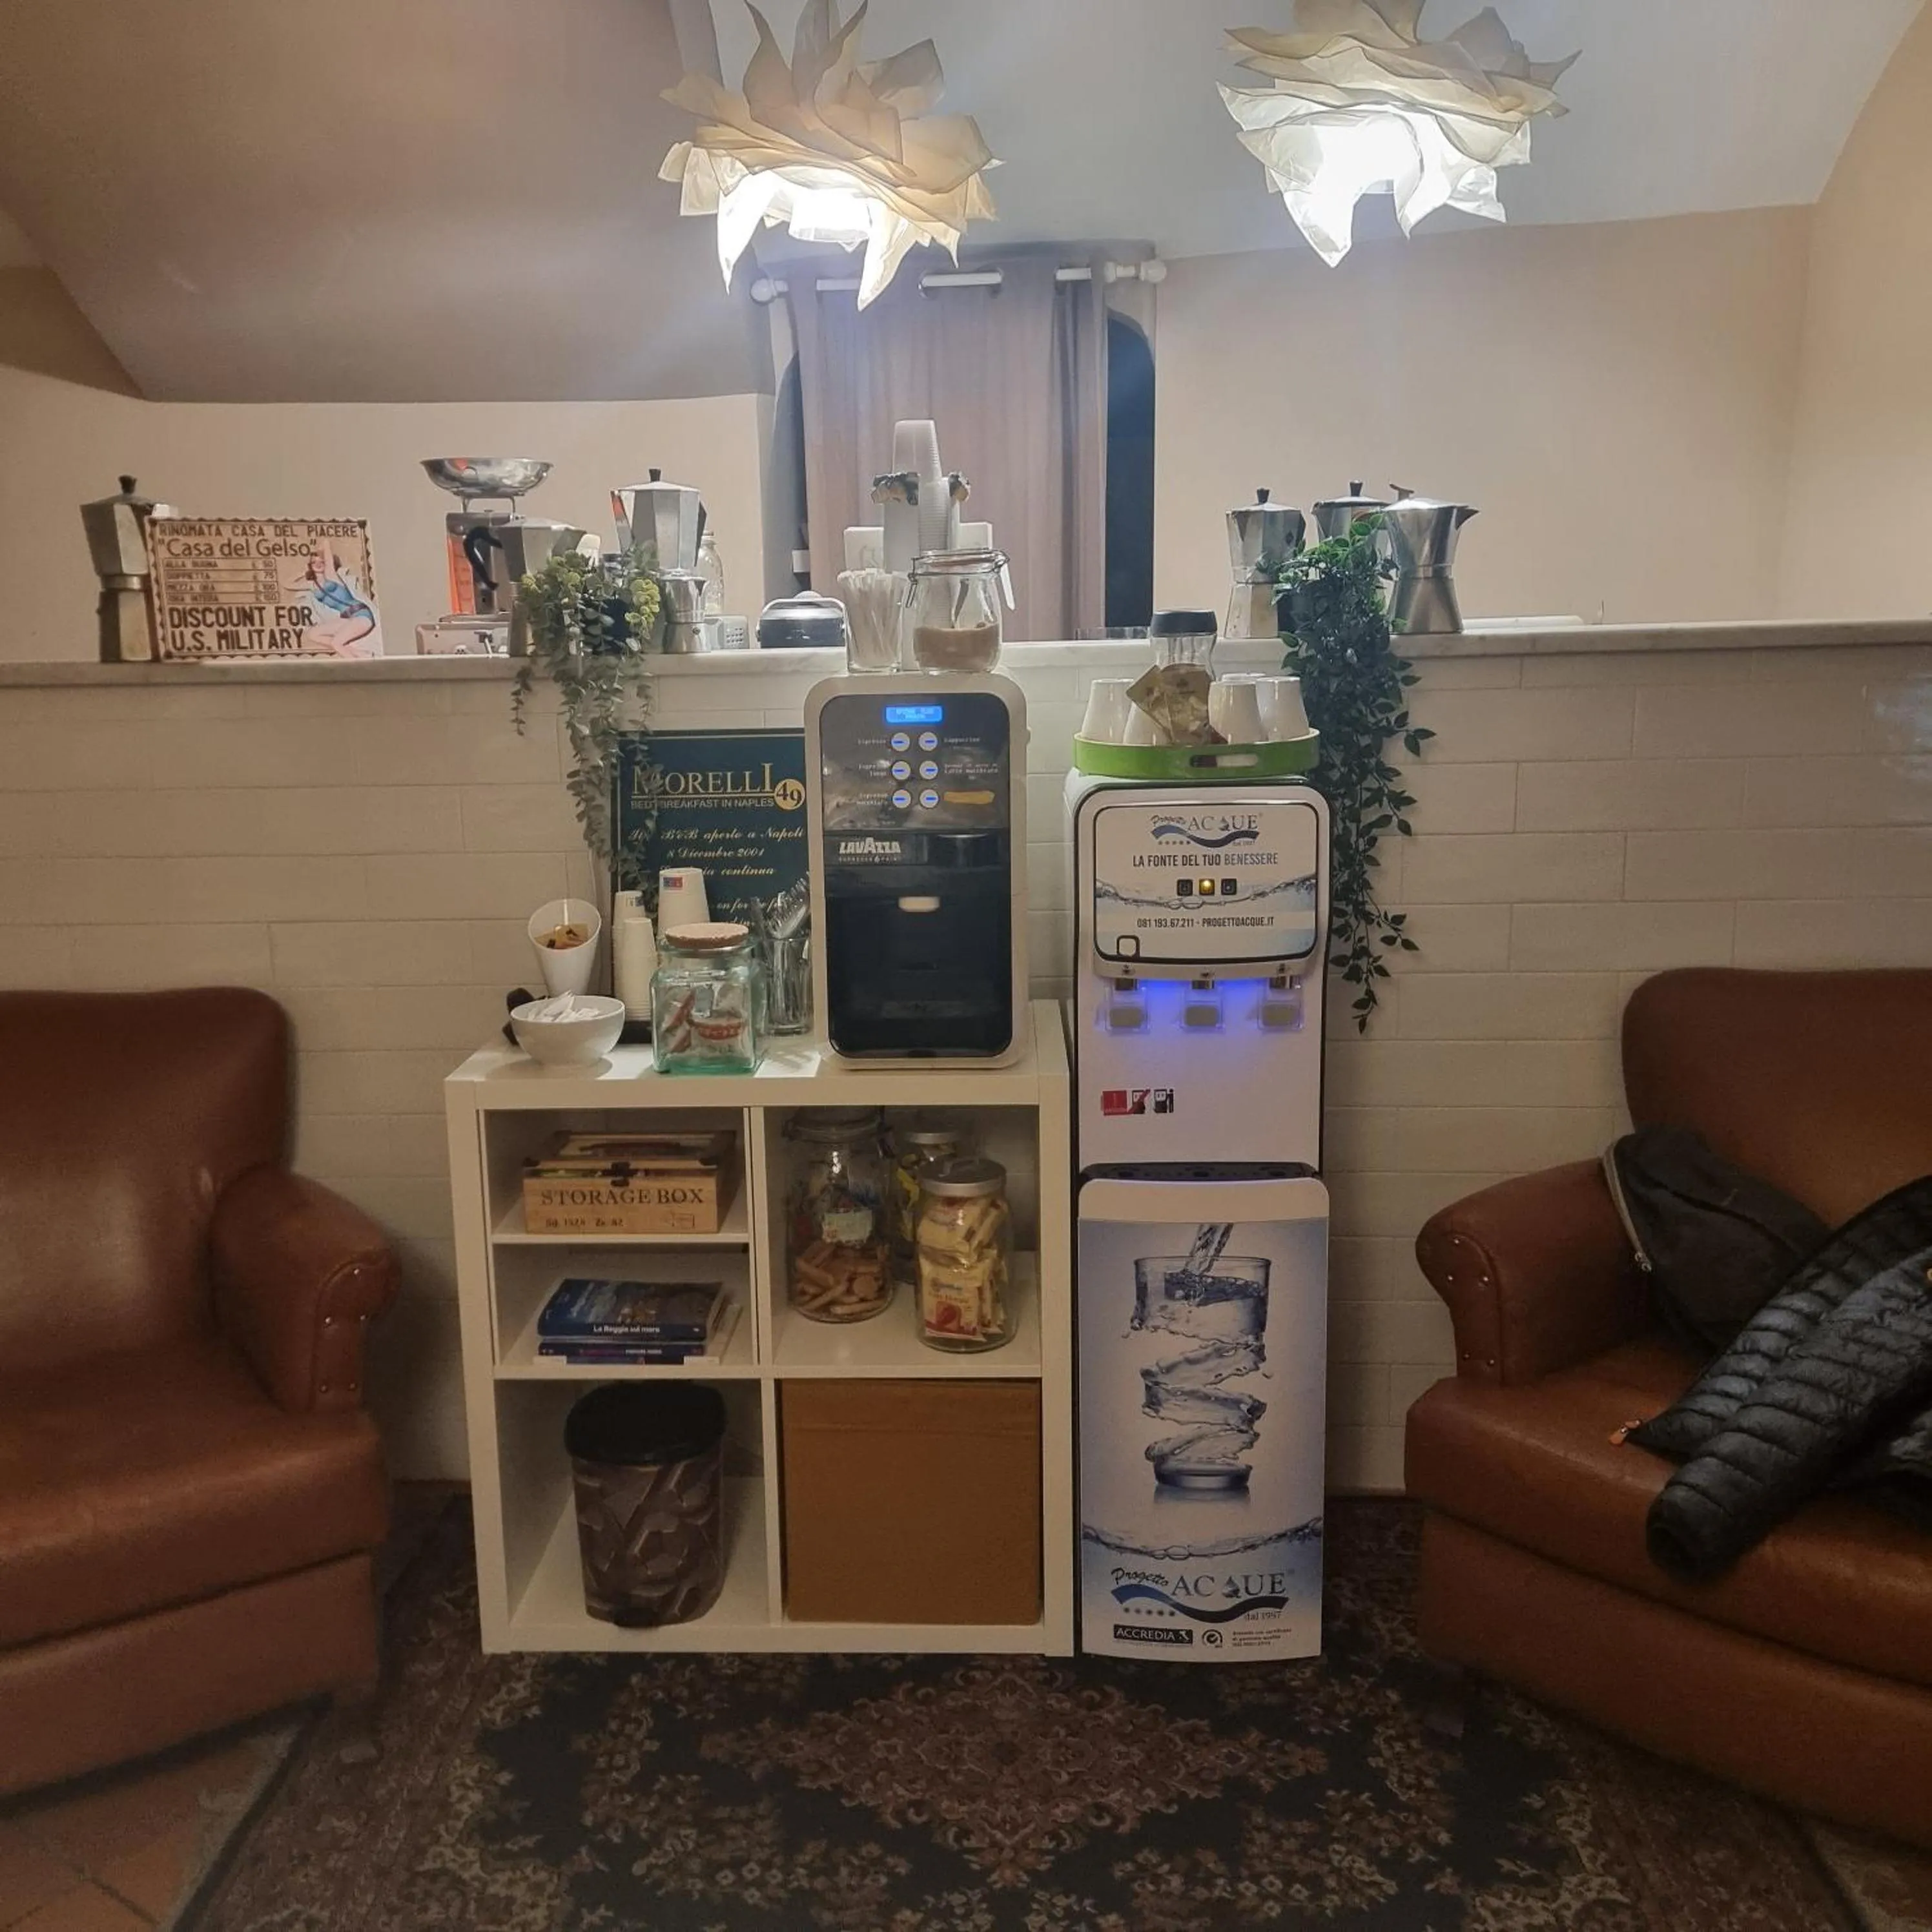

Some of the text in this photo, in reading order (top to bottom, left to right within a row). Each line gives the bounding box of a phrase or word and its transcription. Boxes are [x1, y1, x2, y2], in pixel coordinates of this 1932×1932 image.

[159, 524, 358, 538] RINOMATA CASA DEL PIACERE
[220, 538, 249, 557] del
[169, 606, 313, 630] DISCOUNT FOR
[171, 628, 305, 652] U.S. MILITARY
[776, 781, 802, 806] 49
[721, 799, 734, 808] IN
[734, 797, 775, 808] NAPLES
[760, 826, 805, 843] Napoli
[737, 847, 765, 858] 2001
[839, 837, 901, 854] LAVAZZA
[1133, 852, 1279, 867] LA FONTE DEL TUO BENESSERE
[721, 865, 776, 876] continua
[1137, 916, 1274, 928] 081 193.67.211 PROGETTOACQUE.IT
[540, 1188, 704, 1206] STORAGE BOX
[1115, 1627, 1176, 1641] ACCREDIA
